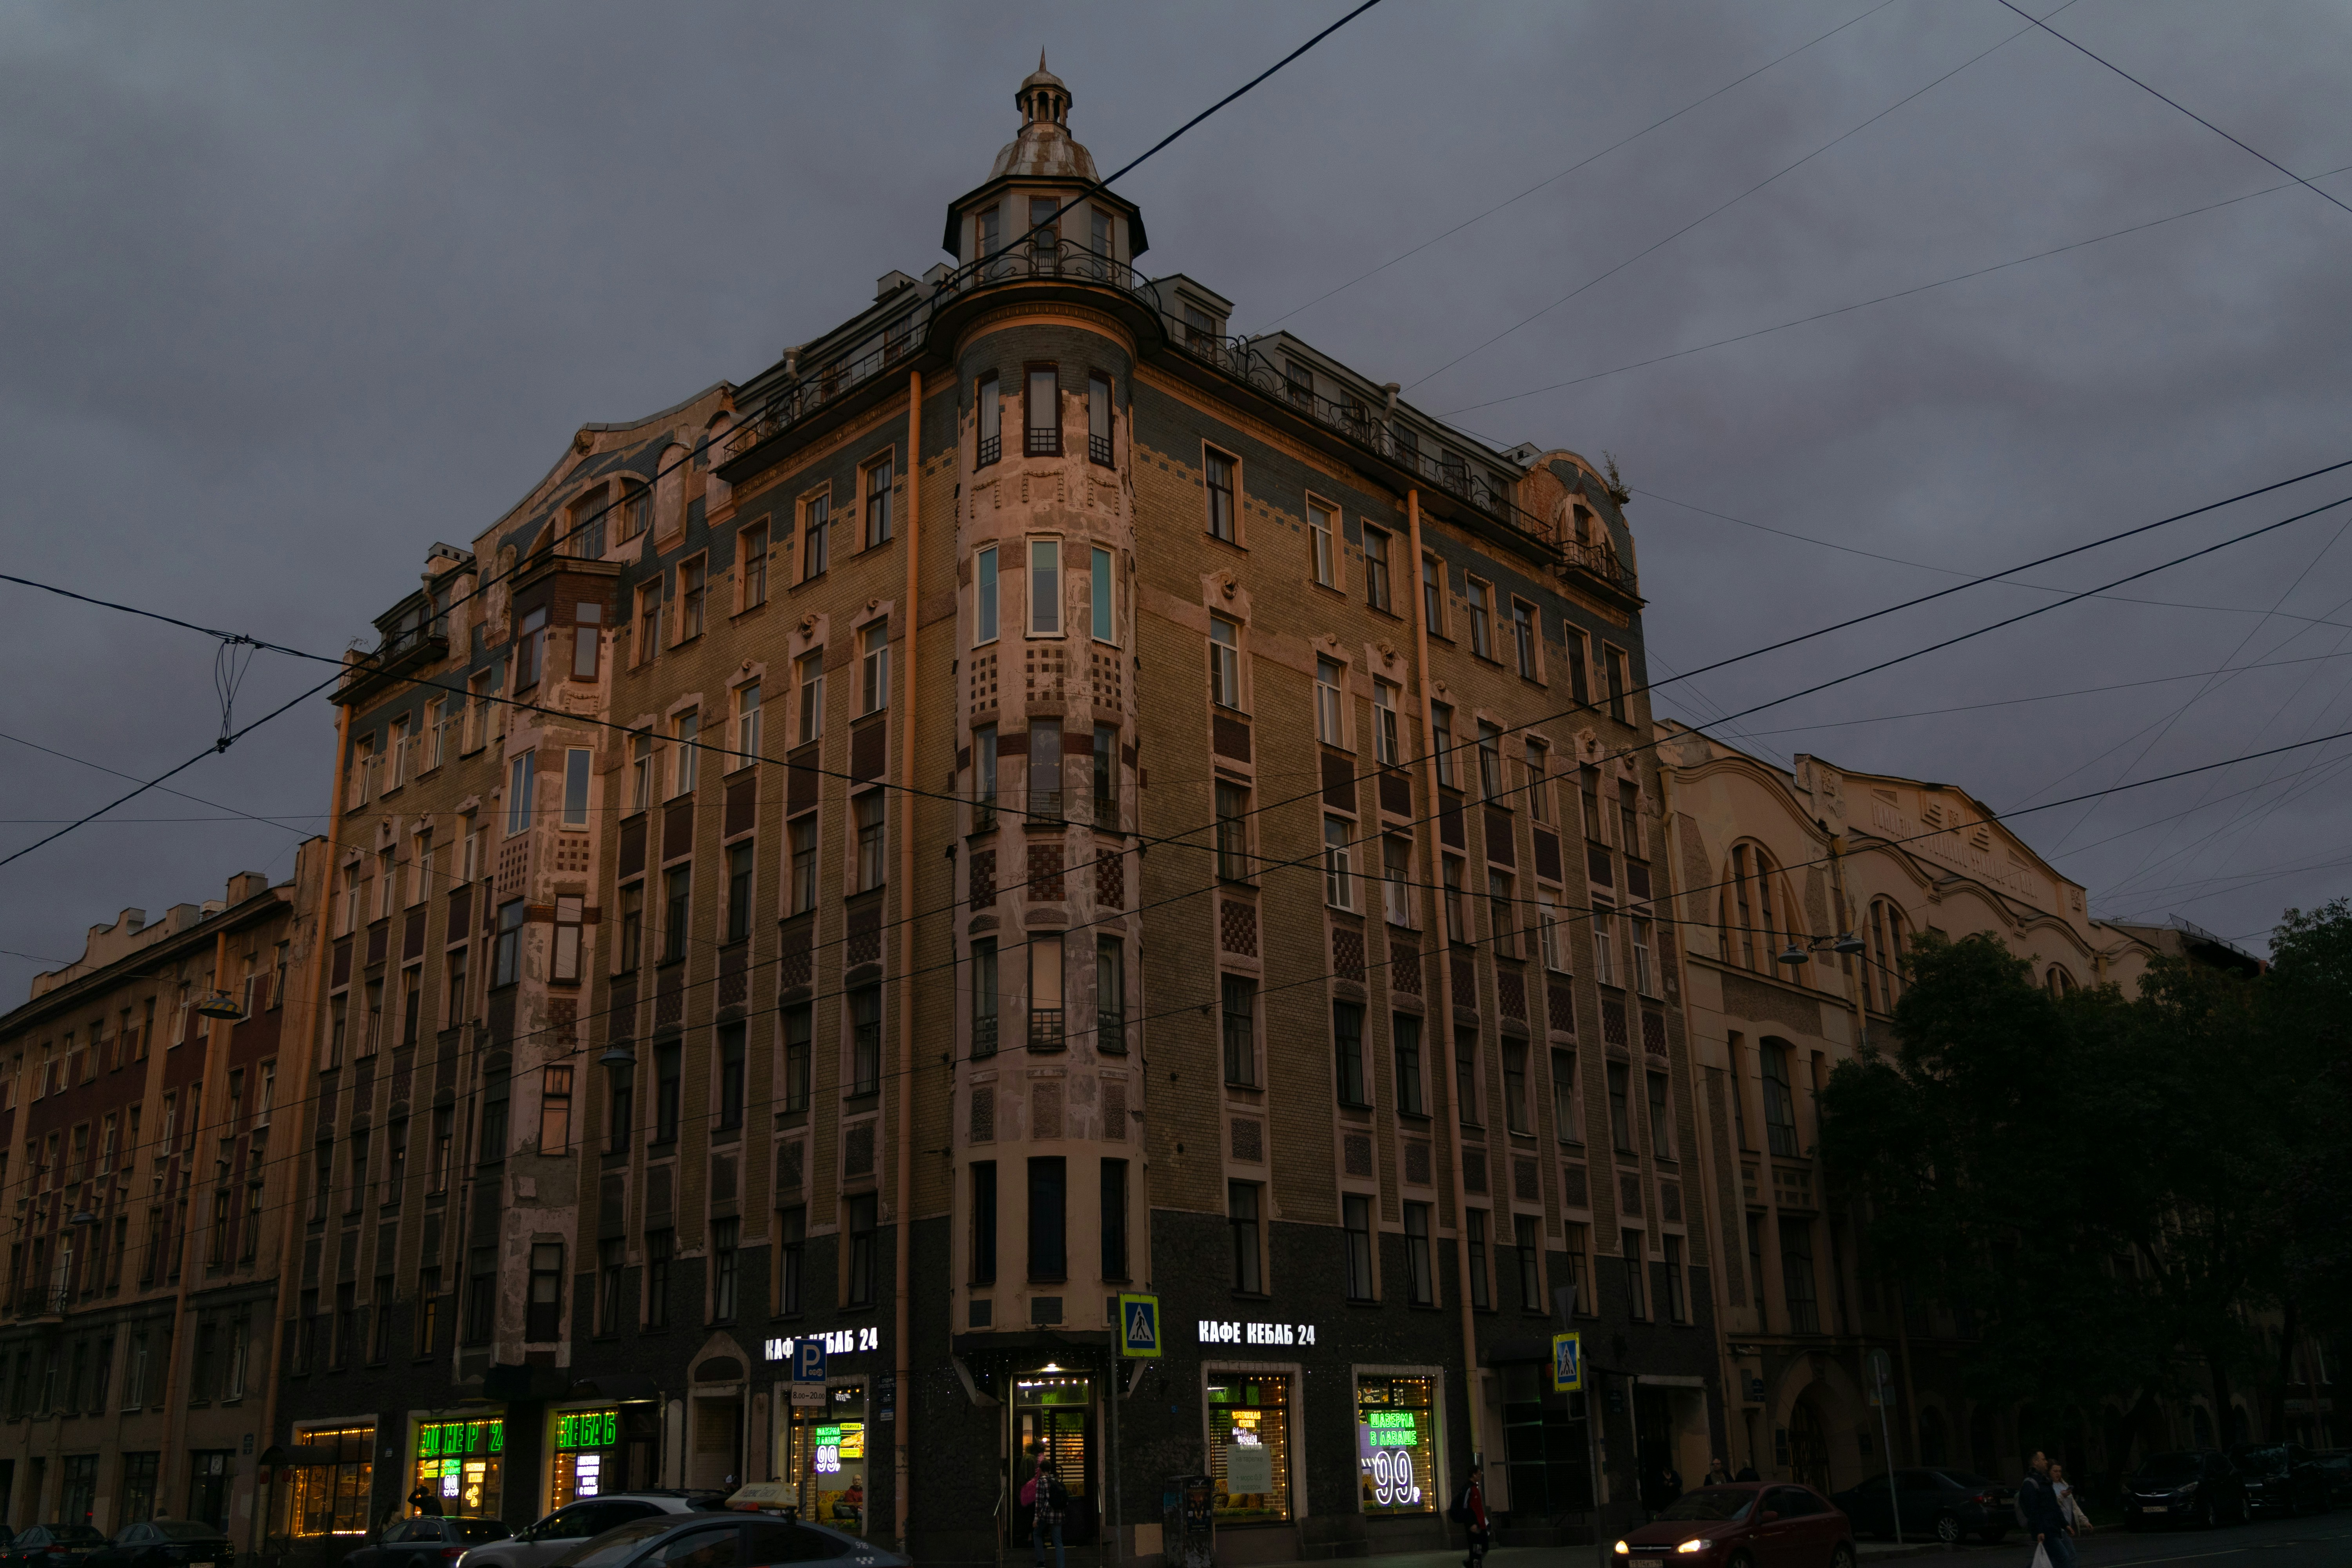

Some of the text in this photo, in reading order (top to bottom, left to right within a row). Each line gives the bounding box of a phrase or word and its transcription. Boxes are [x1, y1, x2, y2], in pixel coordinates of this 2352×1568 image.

[766, 1336, 801, 1360] КАФ
[859, 1327, 878, 1351] 24
[1199, 1321, 1315, 1345] КАФЕ КЕБАБ 24
[560, 1413, 615, 1447] КЕБАБ
[1371, 1413, 1415, 1427] ШАВЕРМА
[421, 1421, 503, 1457] ДОНЕР 2
[1370, 1431, 1417, 1445] В ЛАВАШЕ
